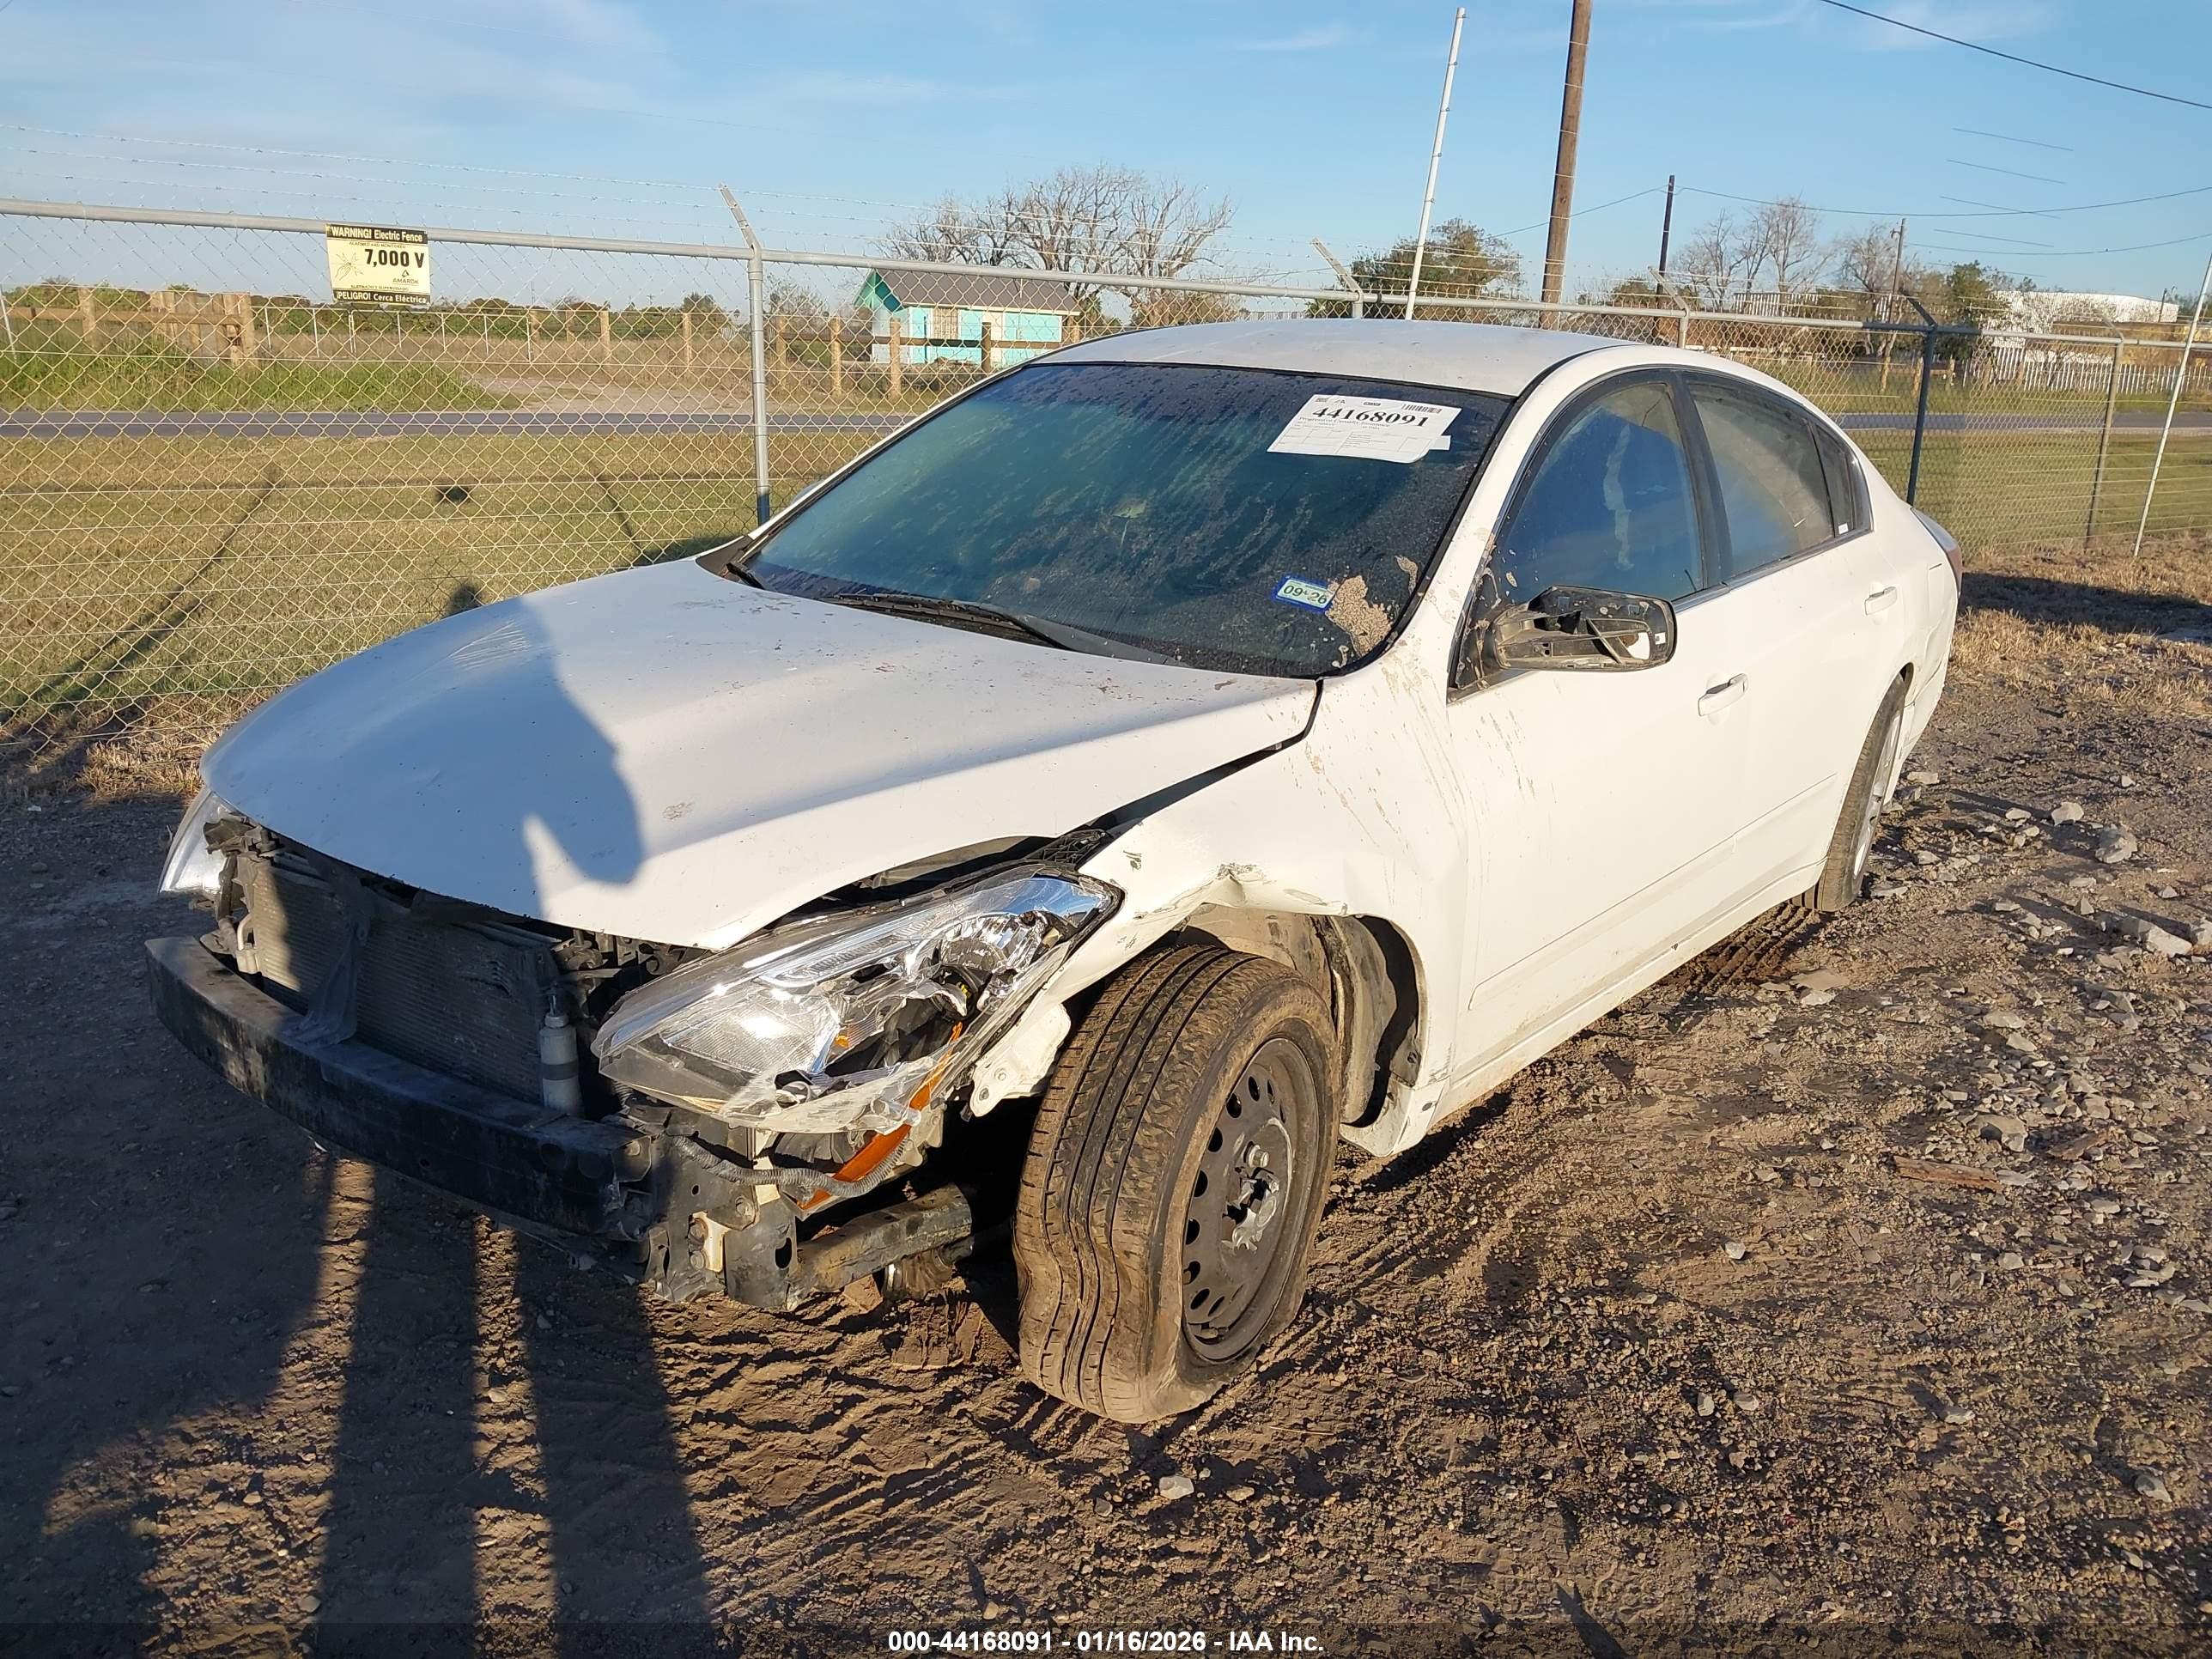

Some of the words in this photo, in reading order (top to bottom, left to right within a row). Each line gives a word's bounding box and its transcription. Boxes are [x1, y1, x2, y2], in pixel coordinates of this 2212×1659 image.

[331, 226, 372, 239] WARNING!
[374, 229, 400, 240] Electric
[402, 232, 422, 241] Fence
[364, 248, 410, 268] 7,000
[414, 252, 425, 269] V
[336, 291, 371, 301] ¡PELIGRO!
[373, 293, 393, 302] Cerca
[395, 295, 427, 304] Eléctrica
[1312, 407, 1429, 427] 44168091
